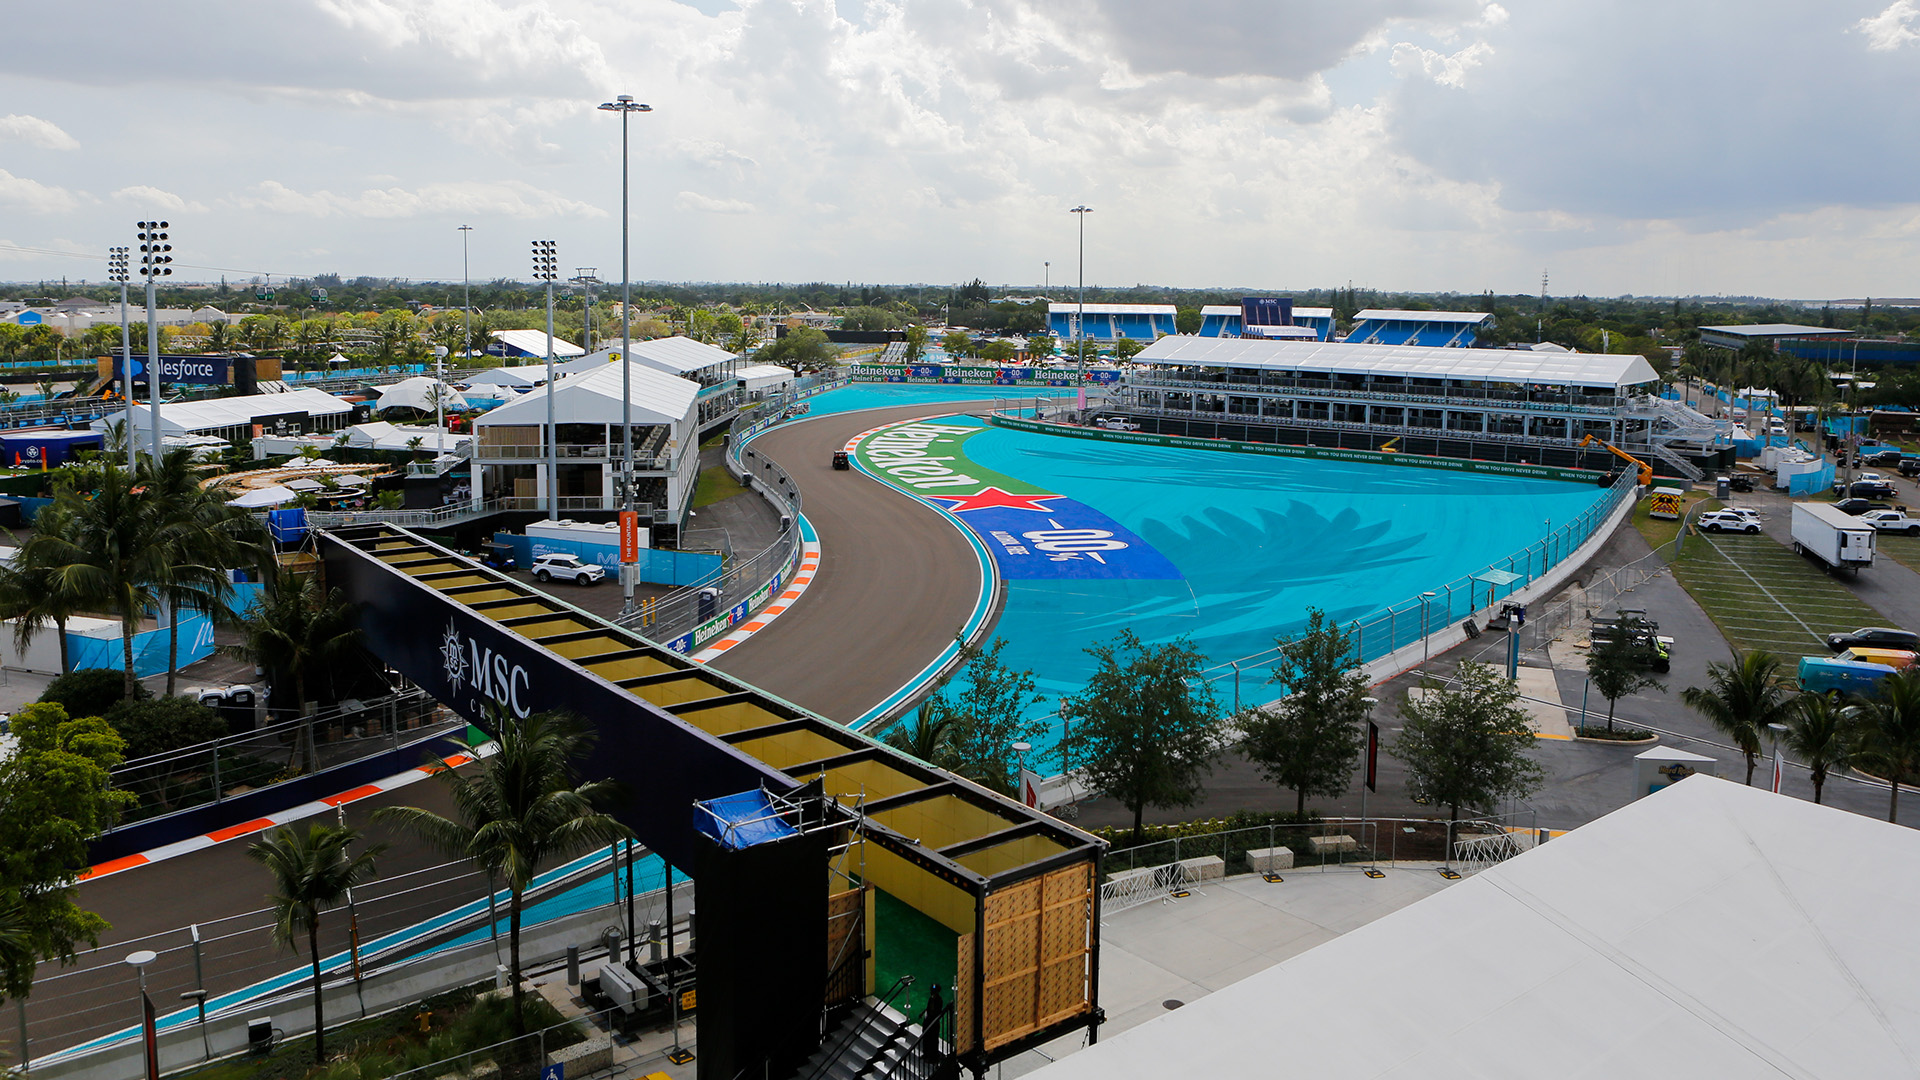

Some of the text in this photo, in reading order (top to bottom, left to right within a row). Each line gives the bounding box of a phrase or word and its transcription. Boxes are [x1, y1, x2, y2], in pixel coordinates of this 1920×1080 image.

[146, 359, 213, 380] slesforce
[853, 365, 901, 376] Heineken
[945, 367, 992, 378] Heineken
[866, 424, 983, 489] Heineken
[695, 618, 727, 646] Heineken
[469, 637, 531, 719] MSC
[1659, 766, 1677, 774] Hard
